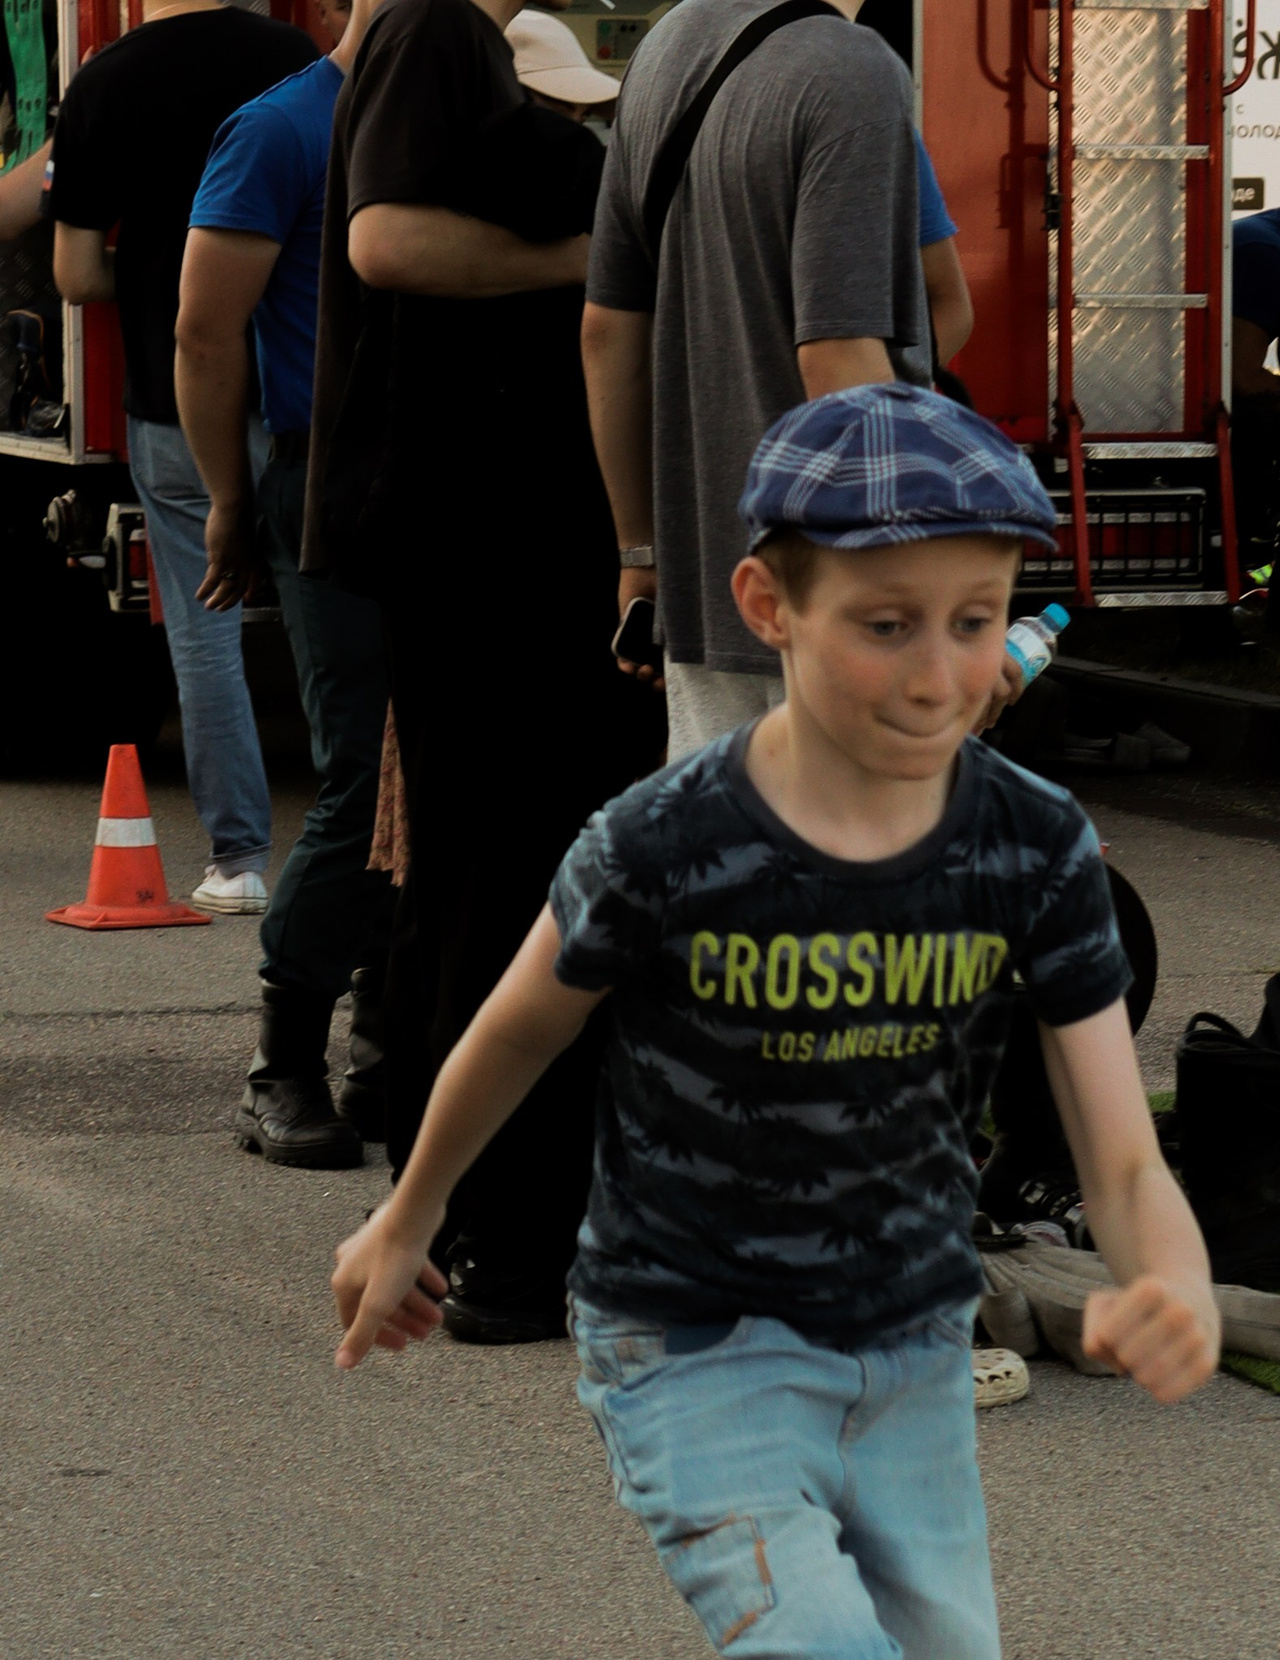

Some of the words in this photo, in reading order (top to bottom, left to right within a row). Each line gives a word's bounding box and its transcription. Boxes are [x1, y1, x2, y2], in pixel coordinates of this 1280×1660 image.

[690, 930, 1009, 1010] CROSSWIND
[762, 1031, 815, 1061] LOS
[823, 1022, 941, 1062] ANGELES
